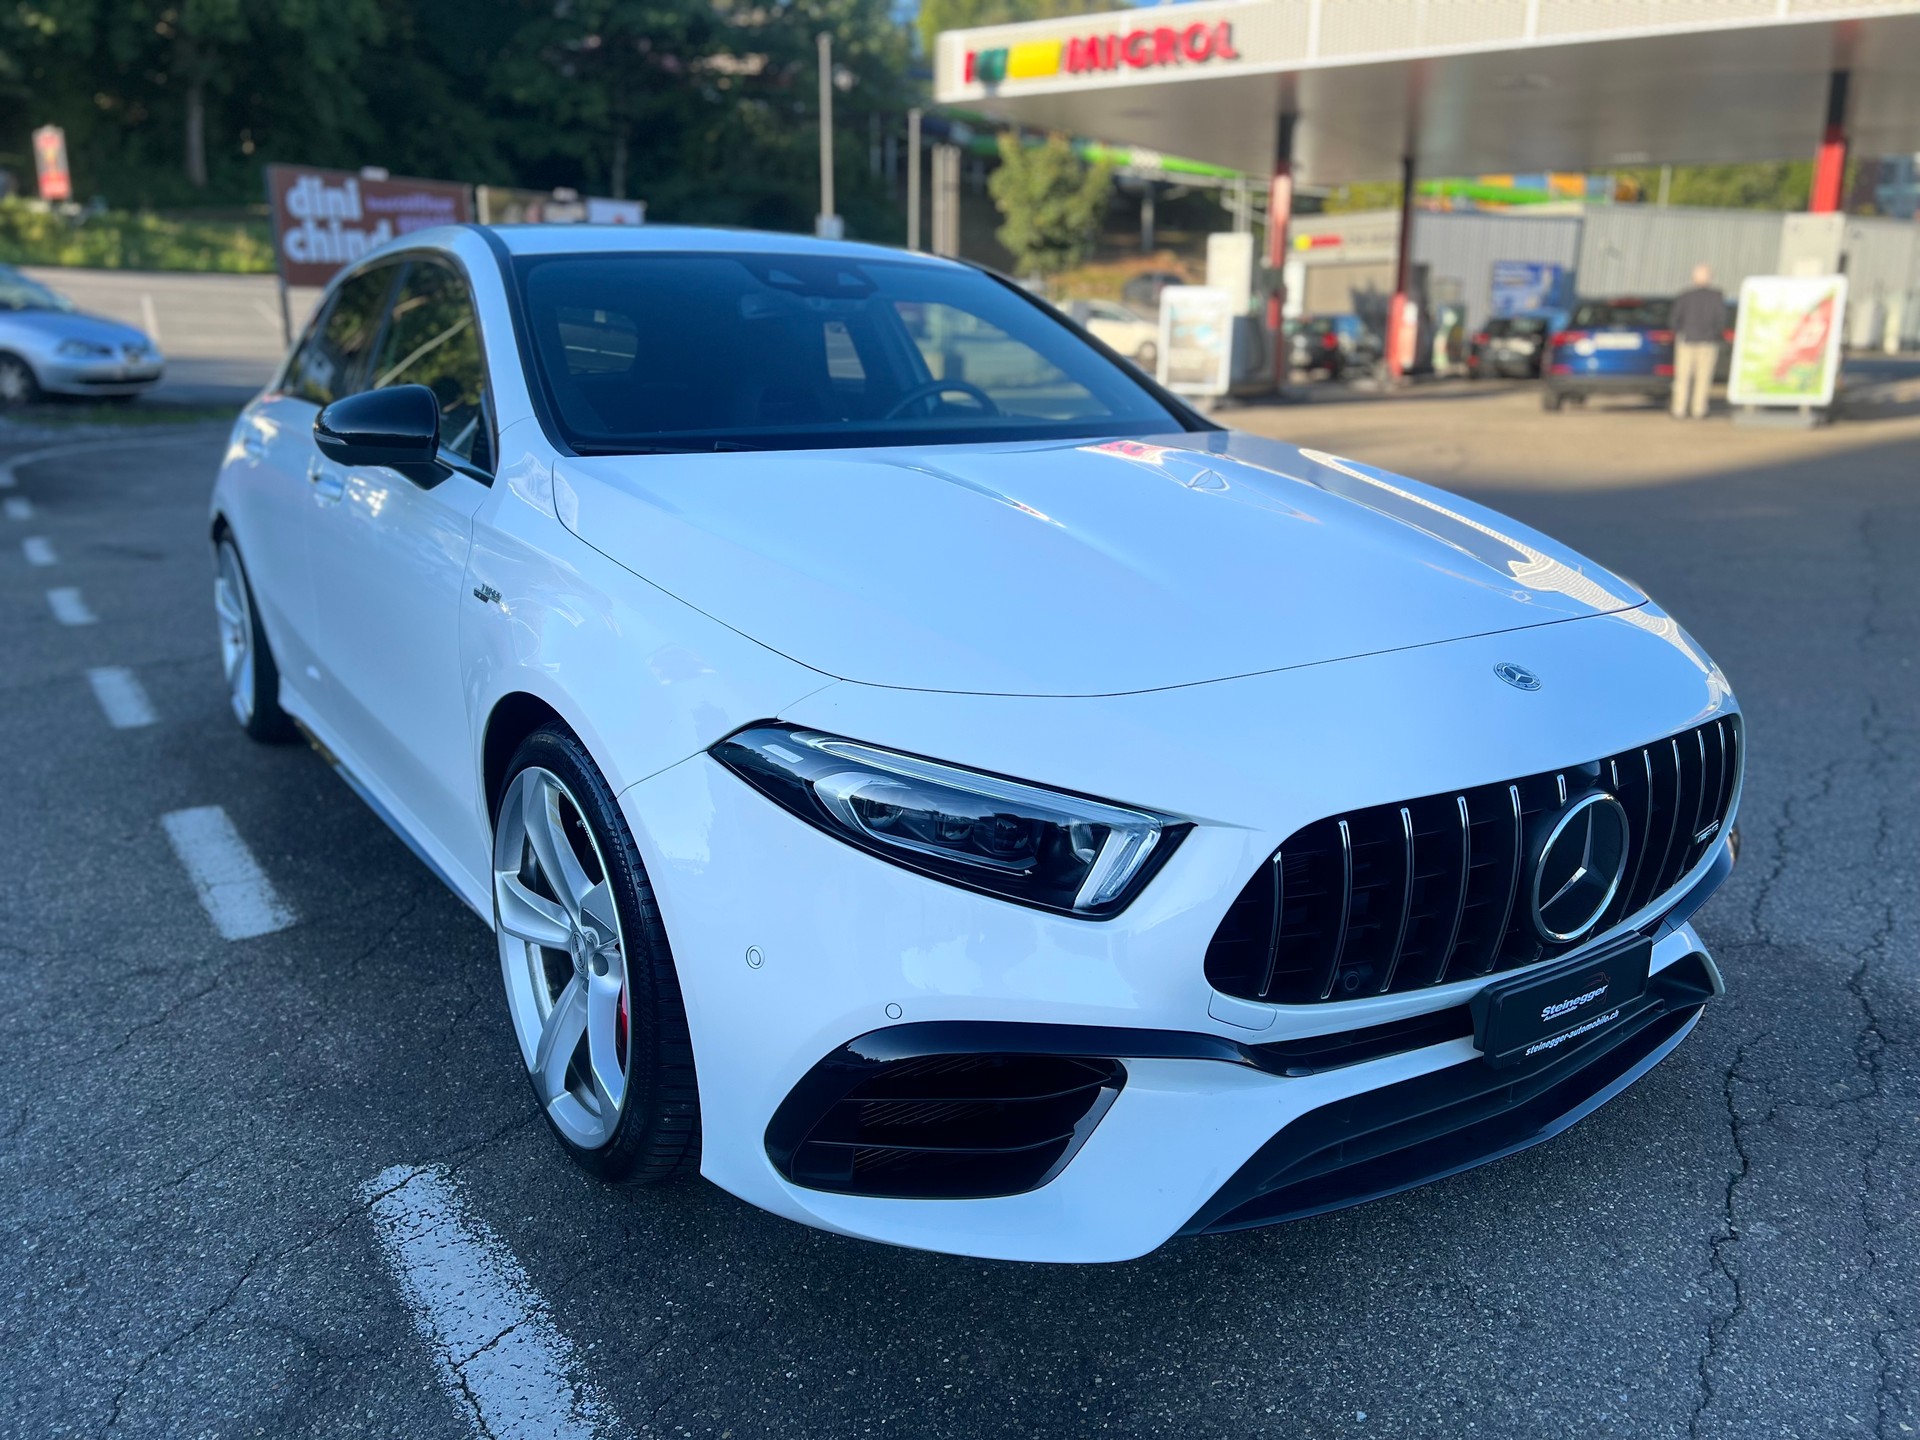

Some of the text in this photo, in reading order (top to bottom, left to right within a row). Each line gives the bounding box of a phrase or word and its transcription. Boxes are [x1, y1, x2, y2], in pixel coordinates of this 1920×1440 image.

[1065, 21, 1239, 74] MIGROL
[286, 175, 363, 221] dini
[1540, 984, 1609, 1018] Steinegger
[1525, 1009, 1620, 1056] steinegger-automobile.ch
